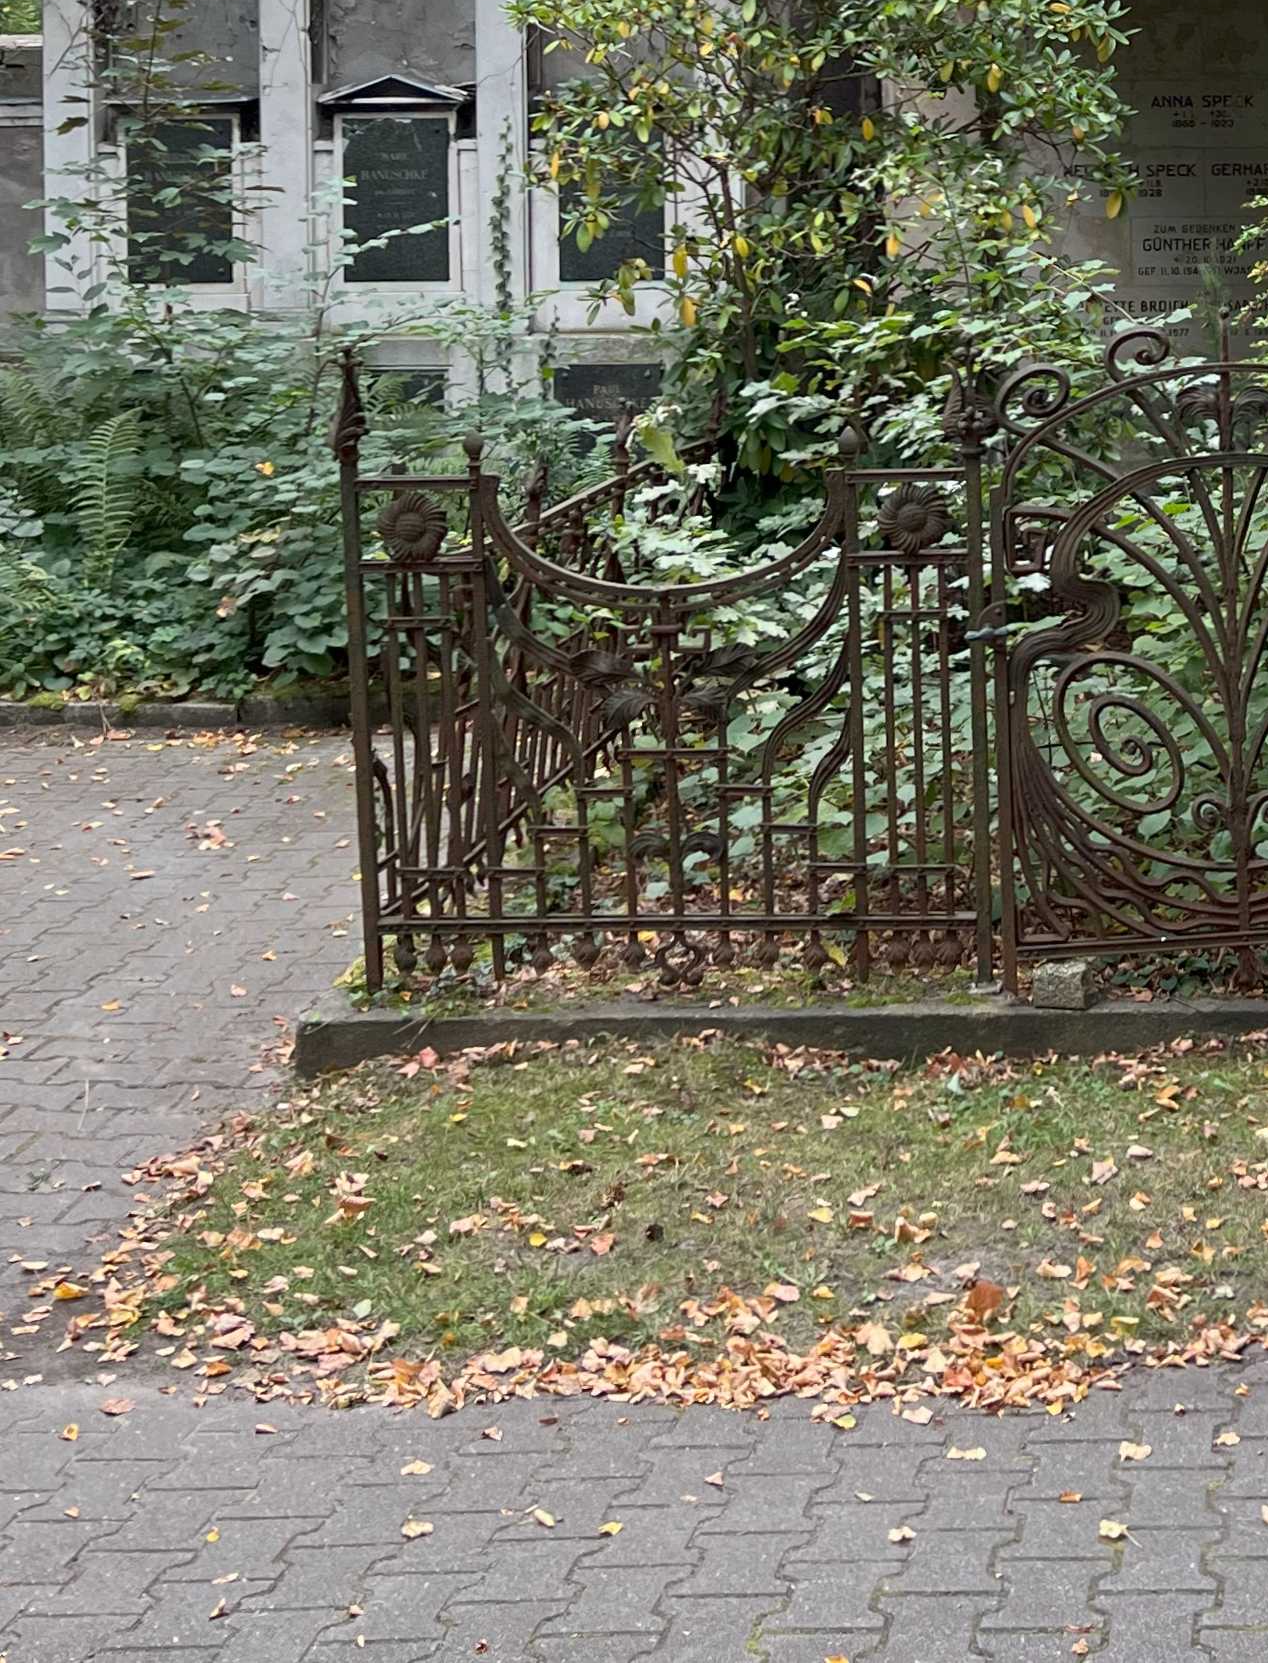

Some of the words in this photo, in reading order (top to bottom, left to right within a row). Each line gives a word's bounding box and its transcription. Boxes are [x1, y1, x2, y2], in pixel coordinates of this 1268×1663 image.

[1151, 95, 1194, 108] ANNA
[1146, 164, 1198, 177] SPECK
[1153, 225, 1177, 234] ZUM
[1142, 236, 1211, 252] GÜNTHER
[592, 384, 621, 395] PAUL
